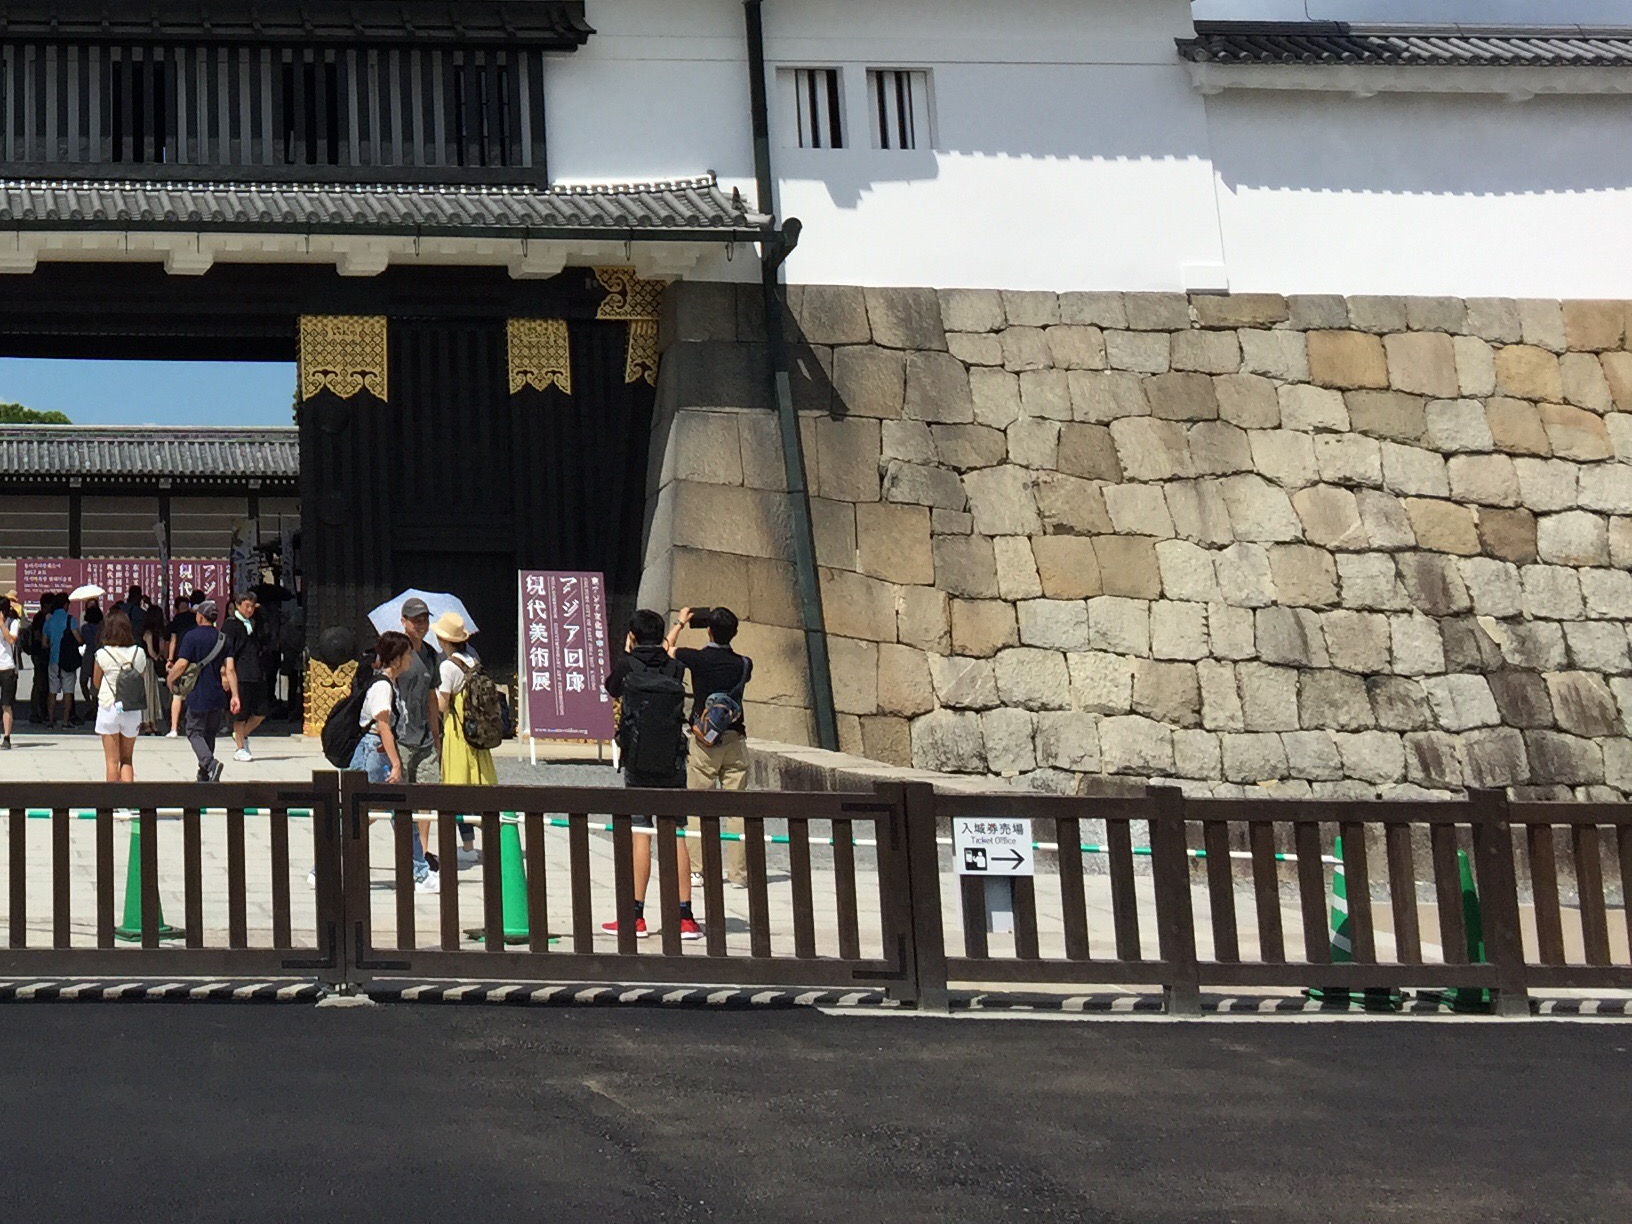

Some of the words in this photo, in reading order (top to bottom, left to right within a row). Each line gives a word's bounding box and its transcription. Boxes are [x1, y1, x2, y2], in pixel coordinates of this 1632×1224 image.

[526, 574, 551, 692] 現代美術展
[560, 576, 584, 693] アジア回廊
[962, 822, 1024, 835] 入城券売場
[995, 836, 1016, 844] Office
